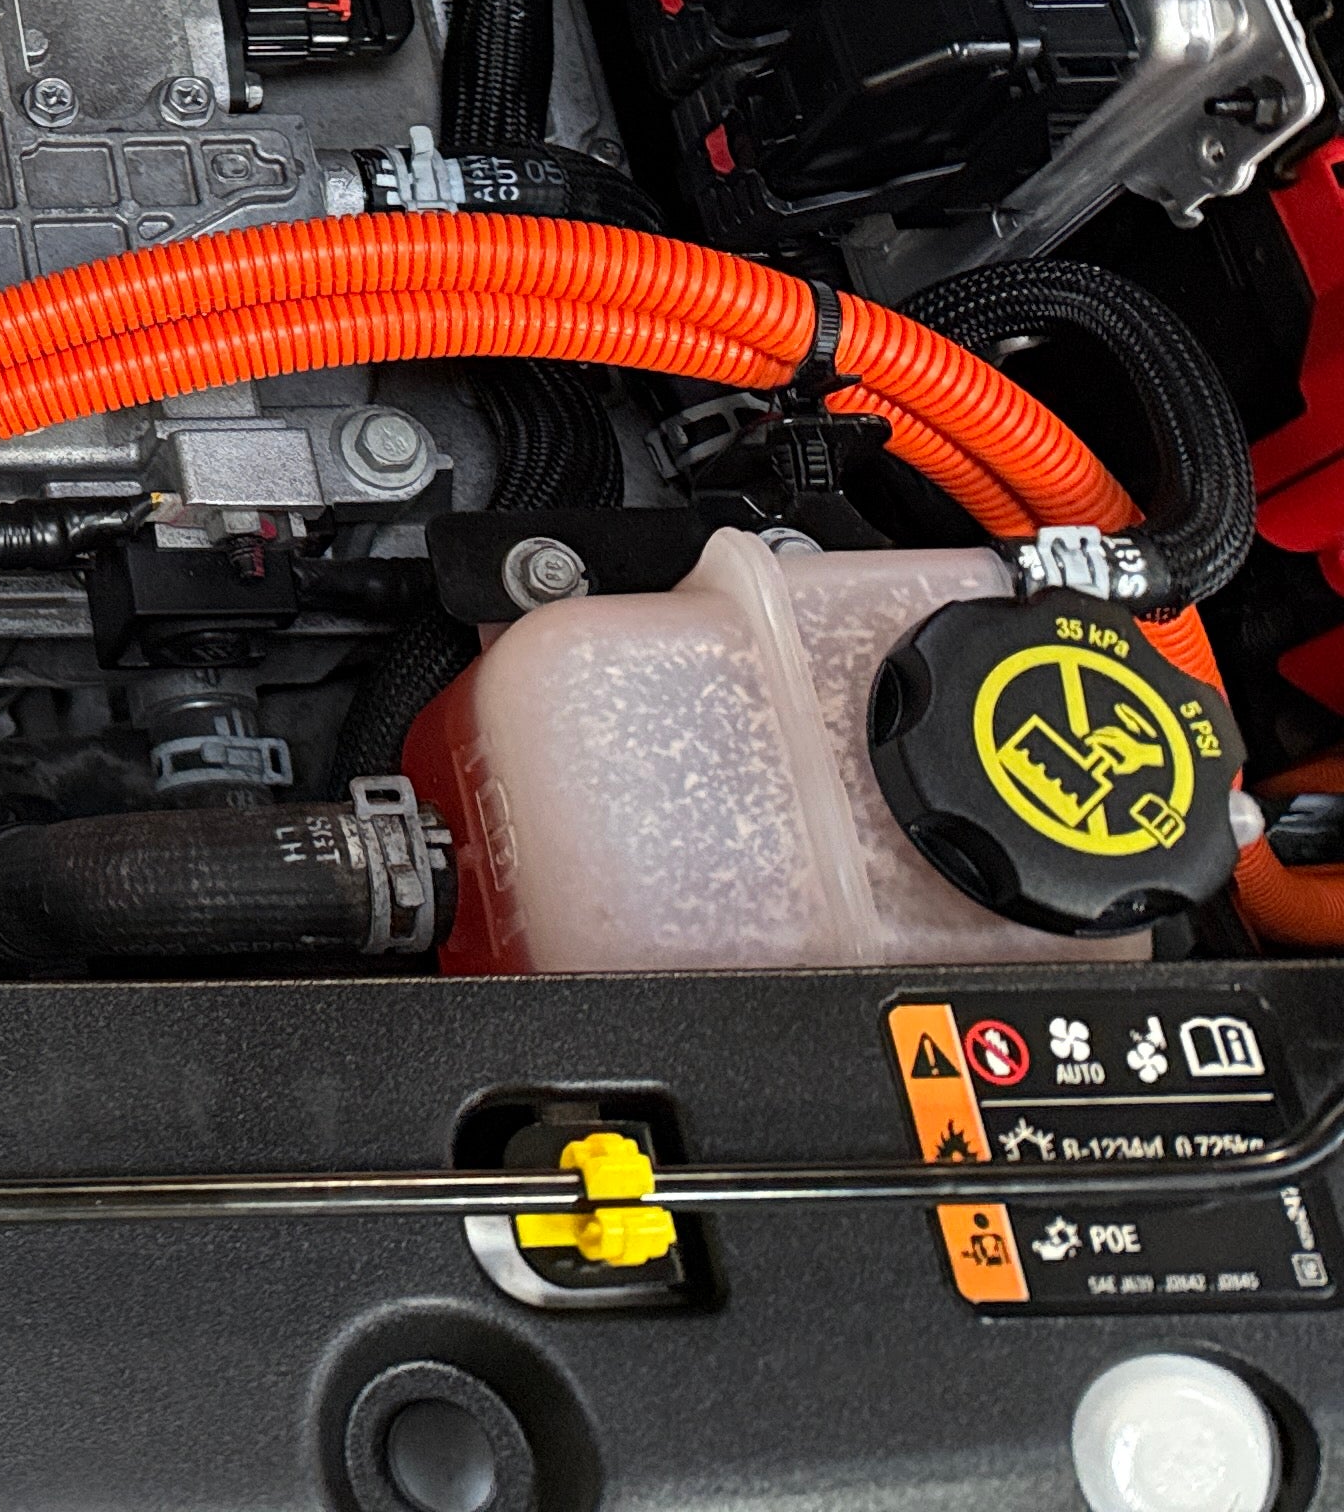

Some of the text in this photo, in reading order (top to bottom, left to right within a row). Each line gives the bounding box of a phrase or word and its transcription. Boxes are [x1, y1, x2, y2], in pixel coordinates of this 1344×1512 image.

[495, 157, 520, 201] OUT
[524, 159, 563, 184] 05
[1055, 617, 1131, 659] 35 kPa
[1180, 700, 1222, 758] 5 PSI
[276, 826, 308, 862] LH
[1056, 1063, 1106, 1085] AUTO
[1088, 1225, 1141, 1254] POE
